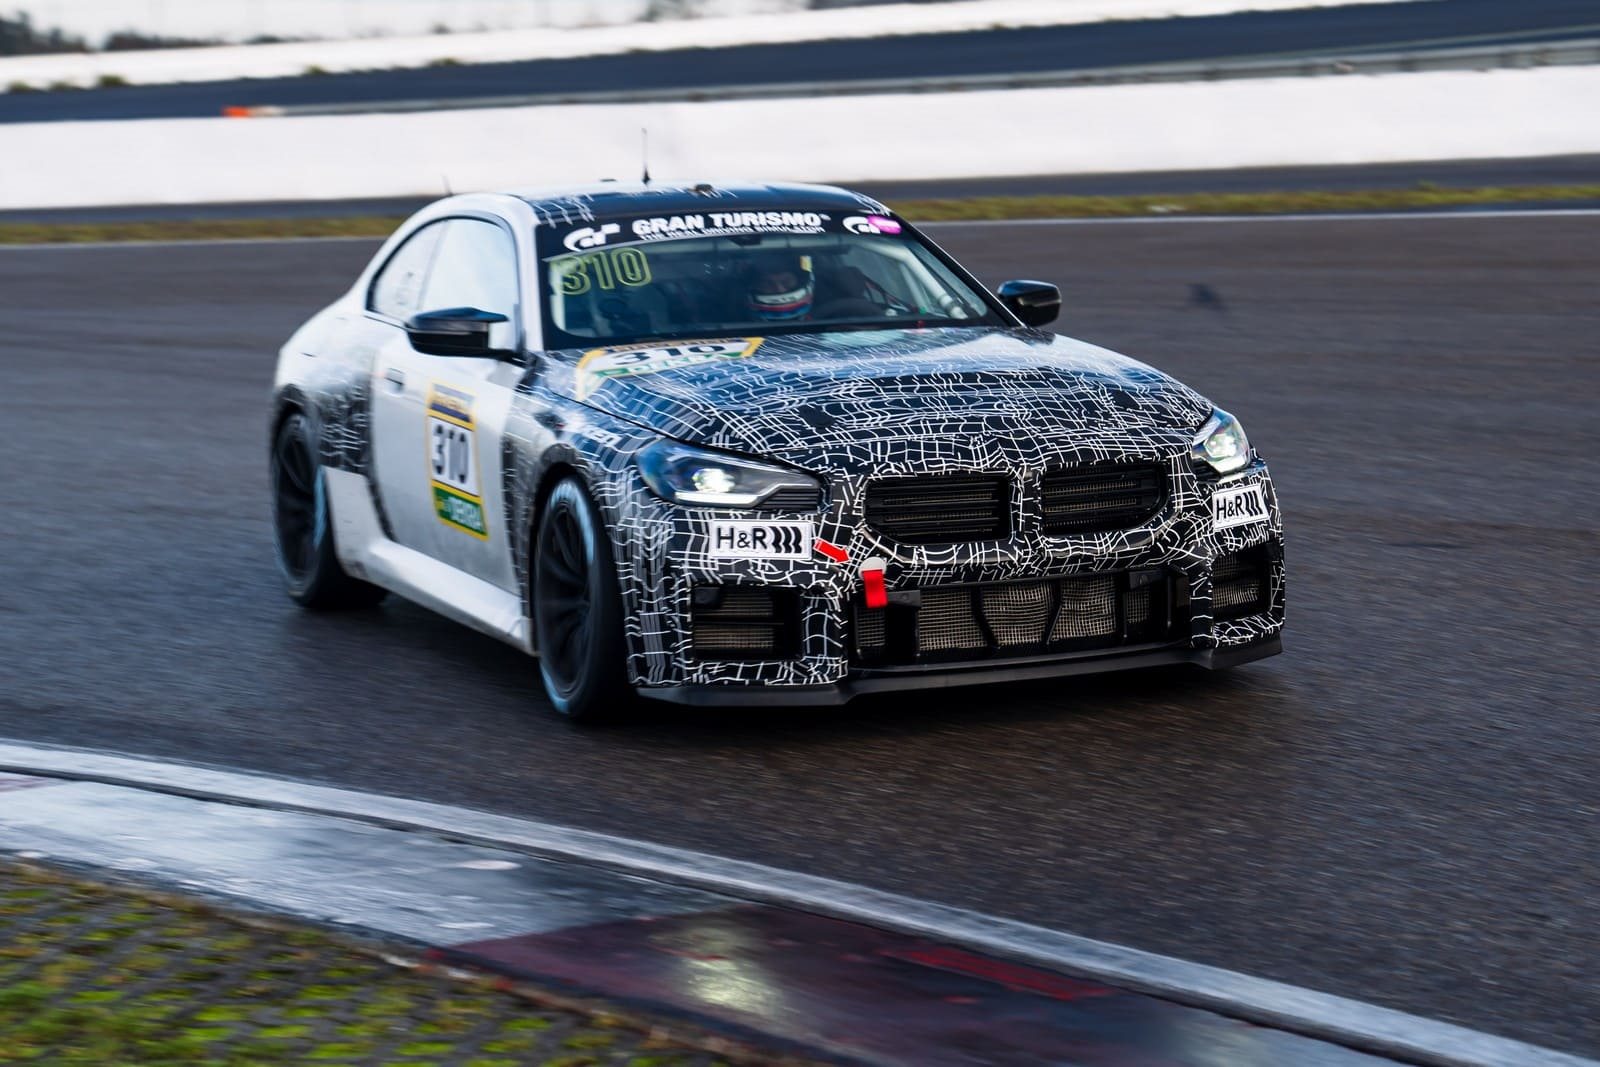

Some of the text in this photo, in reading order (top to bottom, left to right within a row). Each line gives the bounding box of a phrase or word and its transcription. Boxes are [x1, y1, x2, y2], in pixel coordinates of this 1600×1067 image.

[632, 211, 823, 235] GRAN TURISMO
[552, 247, 651, 295] 310
[611, 345, 725, 365] 310
[433, 424, 469, 484] 310
[1216, 495, 1245, 521] H&R
[717, 525, 769, 550] H&R
